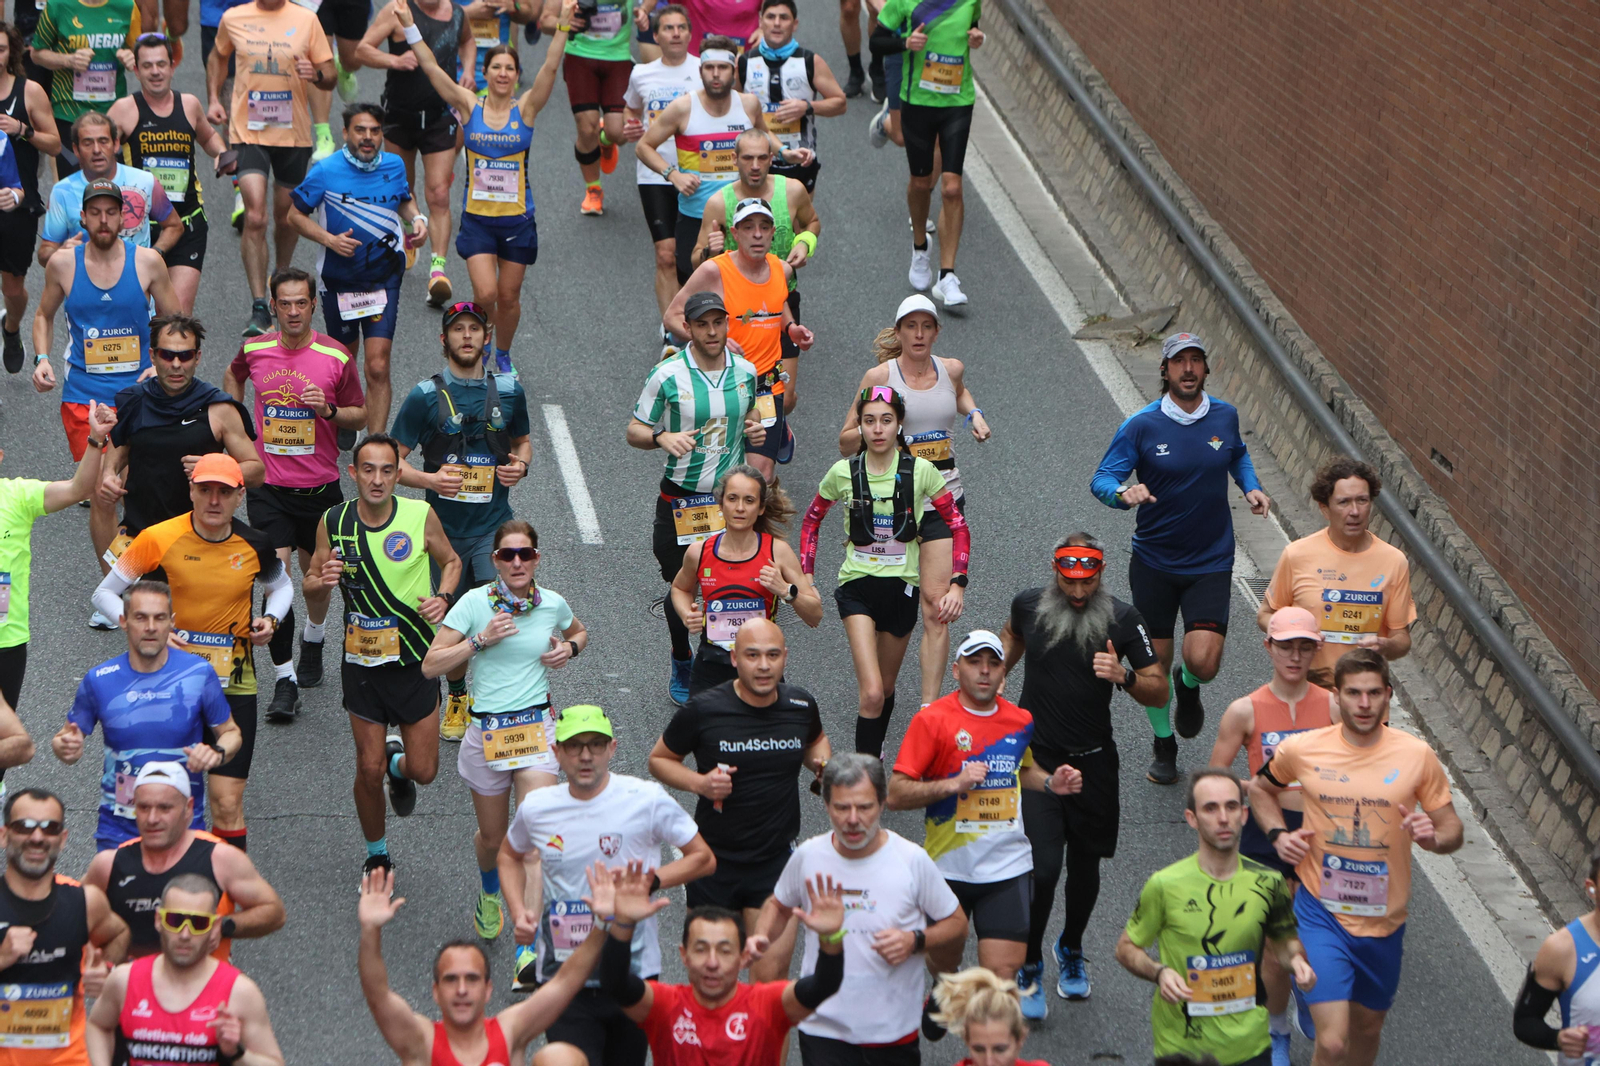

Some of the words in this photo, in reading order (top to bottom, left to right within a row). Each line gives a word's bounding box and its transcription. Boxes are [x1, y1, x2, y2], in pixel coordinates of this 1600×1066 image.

[940, 56, 962, 64] ZURICH
[89, 63, 113, 71] ZURICH
[262, 92, 288, 100] ZURICH
[139, 131, 191, 144] Chorlton
[470, 132, 521, 143] agustinos
[140, 142, 191, 154] Runners
[715, 140, 737, 149] ZURIC
[159, 158, 186, 168] ZURICH
[489, 161, 515, 170] ZURICH
[159, 172, 176, 181] 1870
[488, 174, 505, 182] 7938
[487, 183, 505, 192] MARÍA
[350, 299, 376, 309] NARANJO
[102, 327, 133, 337] ZURICH
[102, 343, 122, 353] 6275
[107, 355, 119, 363] IAN
[279, 409, 309, 418] ZURICH
[278, 424, 297, 435] 4326
[284, 436, 305, 445] COTÁN
[695, 446, 731, 455] network
[917, 447, 936, 458] 5934
[464, 484, 487, 493] VERNET
[692, 511, 709, 521] 3874
[873, 517, 894, 526] ZURIC
[692, 524, 711, 533] RUBÉN
[871, 546, 886, 554] LISA
[1344, 592, 1378, 603] ZURICH
[726, 601, 759, 610] ZURICH
[1342, 609, 1363, 620] 6241
[1344, 624, 1361, 632] PASI
[192, 634, 227, 645] ZURICH
[360, 635, 379, 645] 5667
[1136, 623, 1153, 657] salomon
[96, 664, 121, 678] HOKA
[138, 690, 156, 701] edp
[504, 732, 526, 745] 5939
[719, 736, 802, 753] Run4Schools
[494, 750, 514, 760] AMAT
[514, 745, 540, 757] PINTOR
[980, 778, 1012, 788] ZURICH
[978, 797, 1001, 807] 6149
[1319, 794, 1355, 805] Maratón
[978, 812, 1000, 820] MELLI
[1344, 861, 1381, 874] ZURICH
[1342, 878, 1366, 891] 7127
[1338, 893, 1369, 904] LANDER
[1211, 953, 1248, 968] ZURICH
[184, 1032, 209, 1046] club
